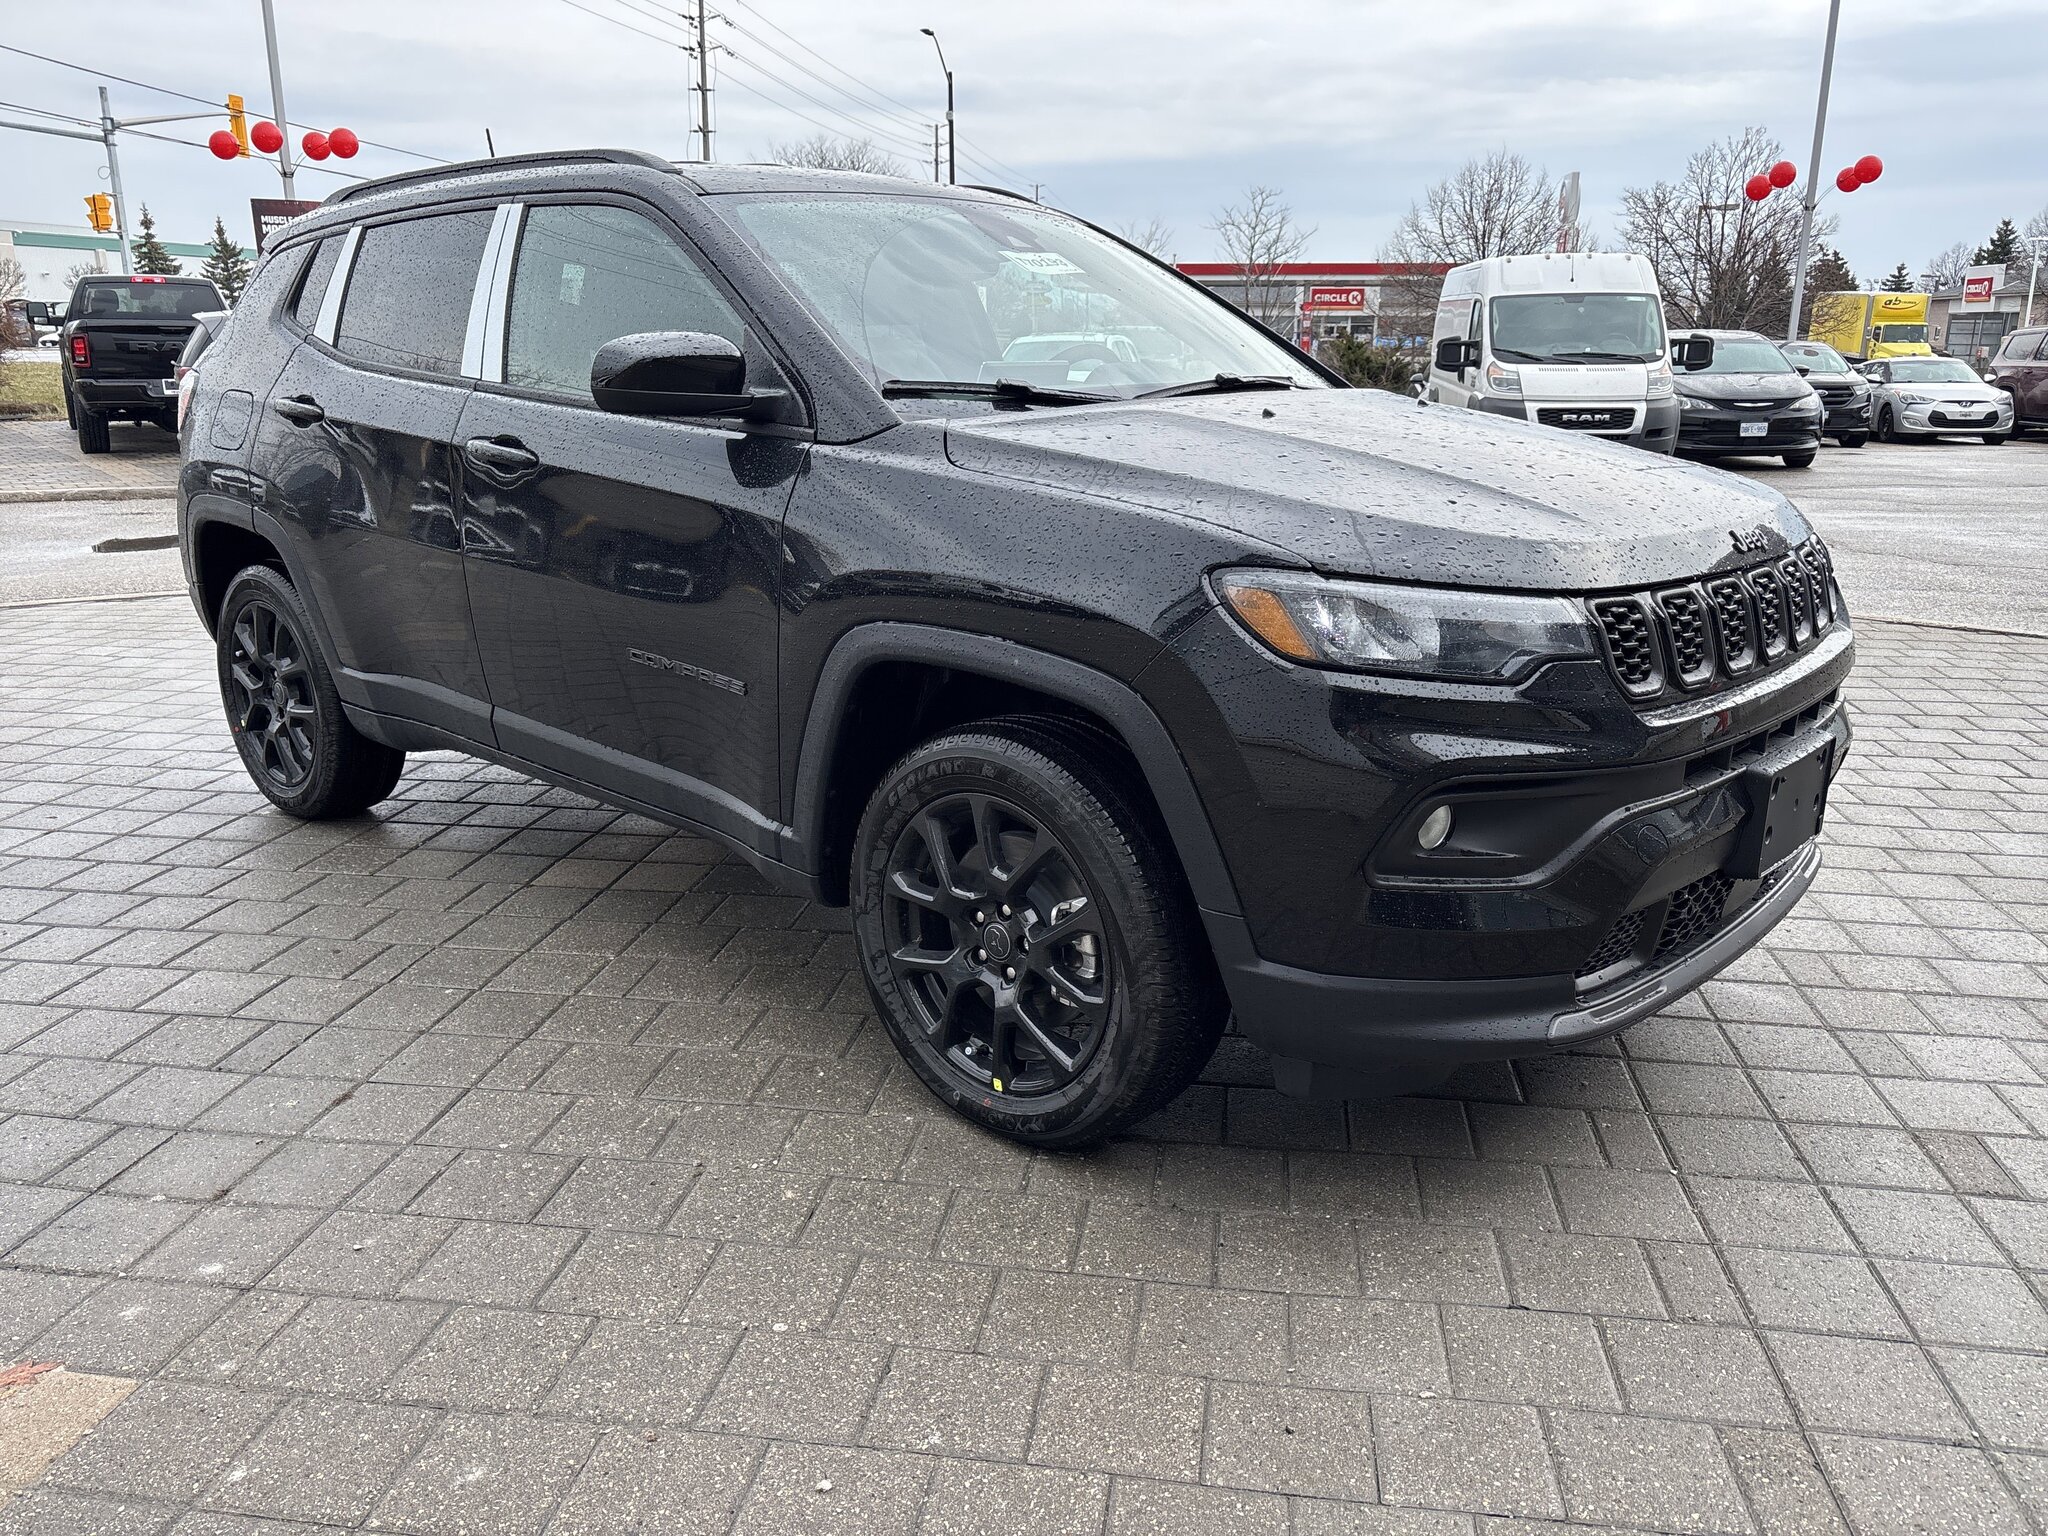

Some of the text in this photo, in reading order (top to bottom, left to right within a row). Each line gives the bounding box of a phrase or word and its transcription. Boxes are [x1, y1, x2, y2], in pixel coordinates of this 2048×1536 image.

[1314, 292, 1361, 303] CIRCLE K
[129, 340, 185, 352] RA
[1562, 414, 1611, 422] RAM
[1728, 529, 1768, 554] Jeep
[626, 647, 748, 696] COMPASS
